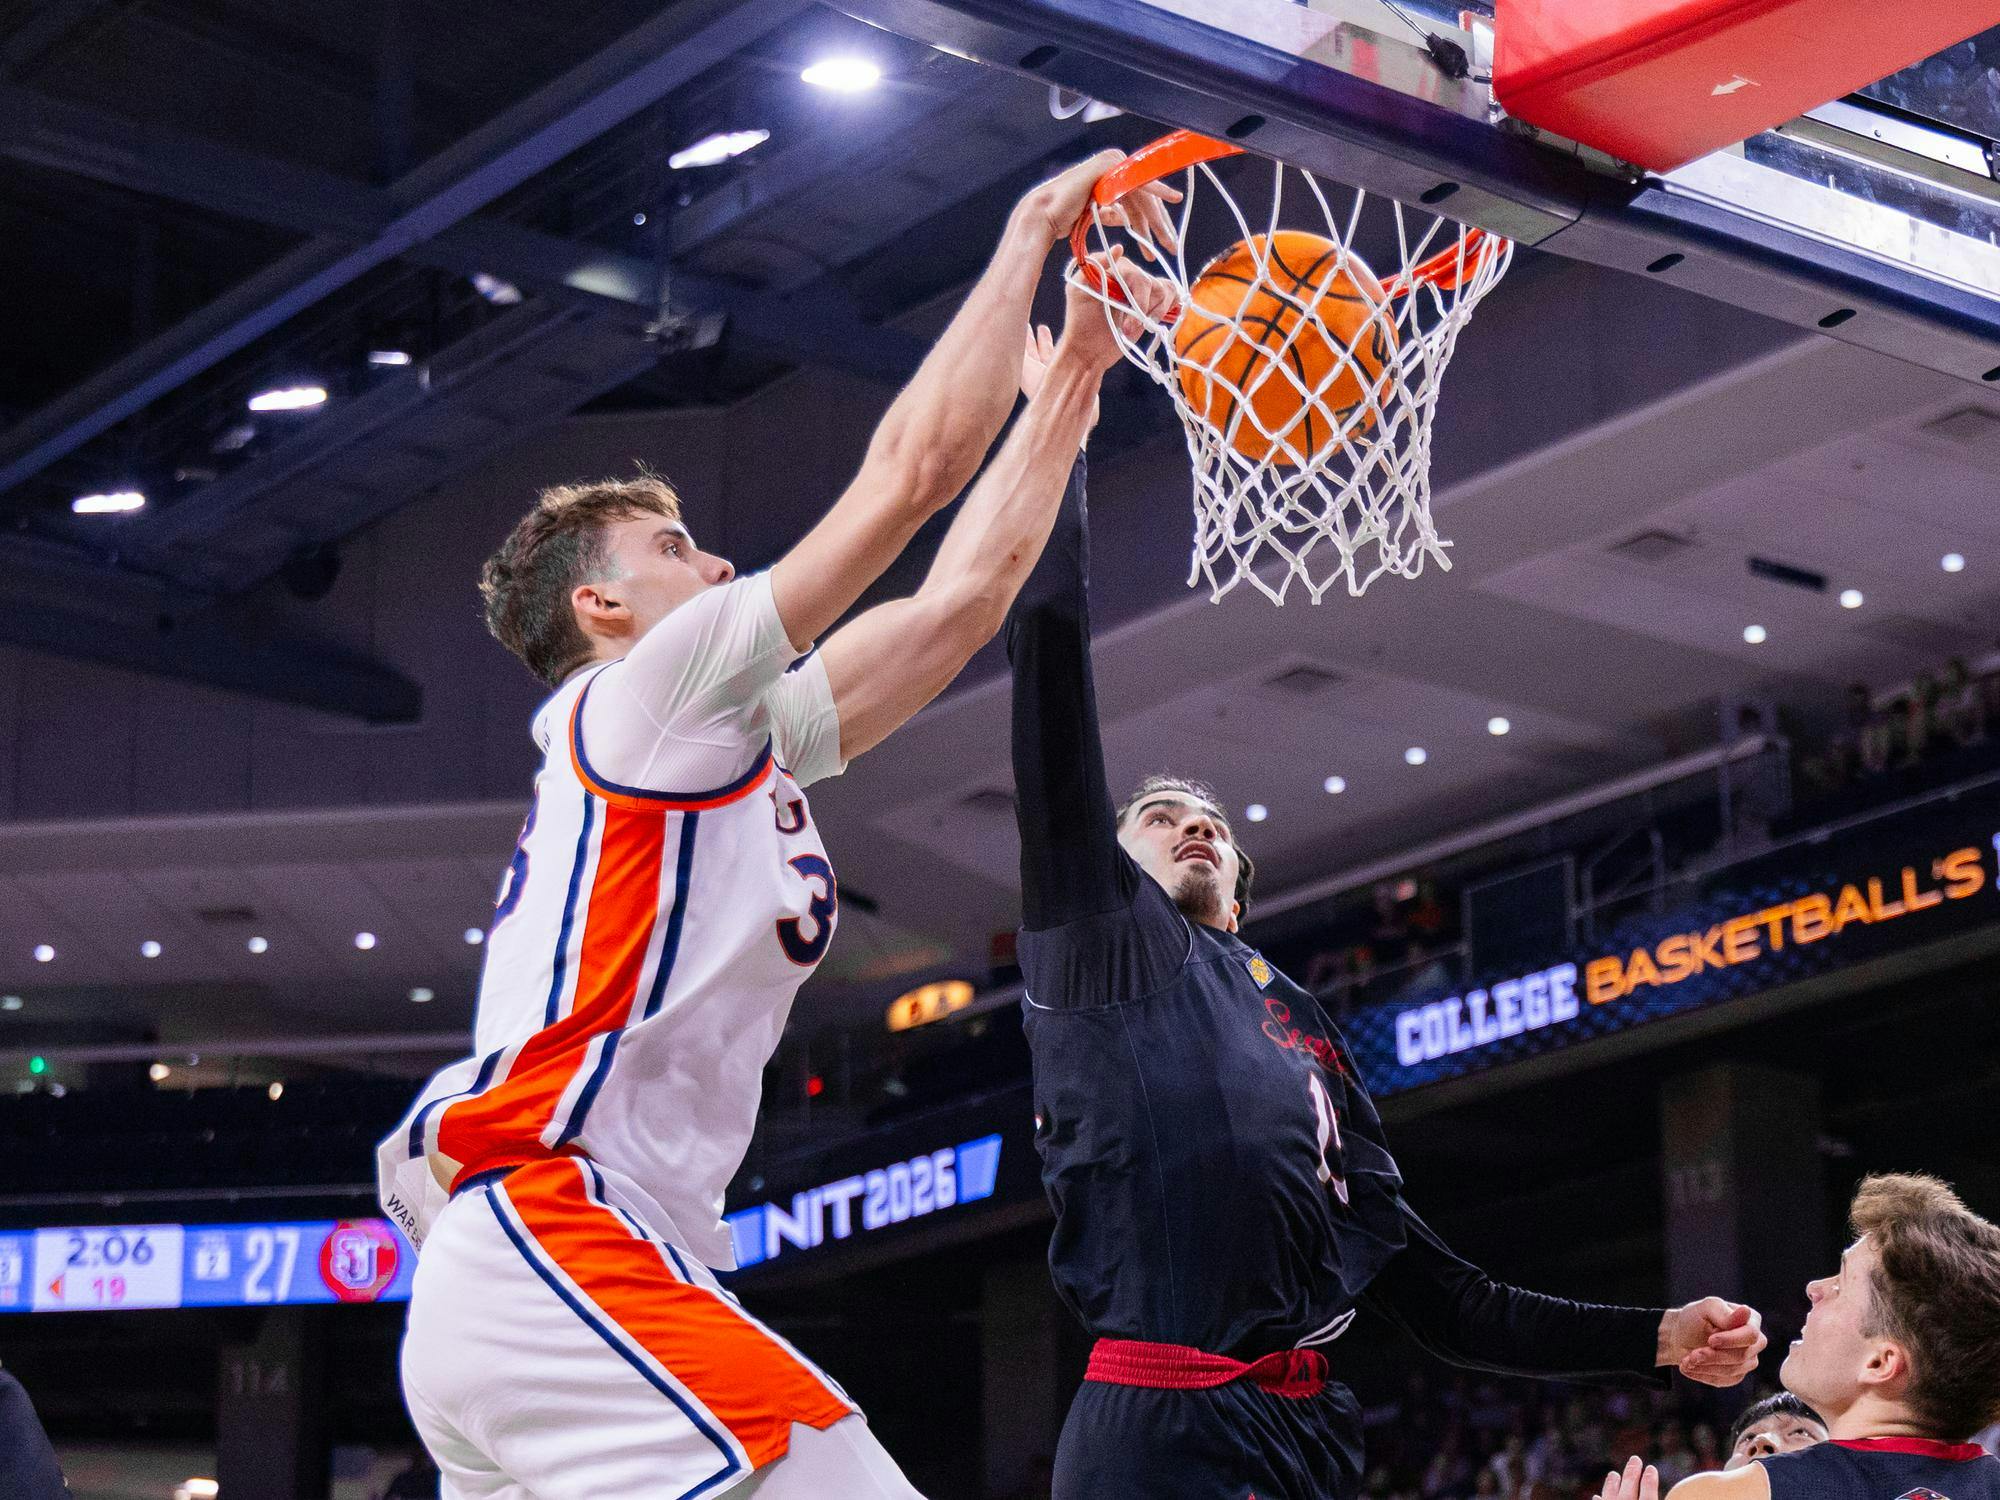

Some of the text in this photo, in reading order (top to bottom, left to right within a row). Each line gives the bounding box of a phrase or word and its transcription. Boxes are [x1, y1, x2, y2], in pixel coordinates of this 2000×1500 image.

[776, 854, 838, 967] 3
[1396, 963, 1580, 1067] COLLEGE
[1586, 846, 1985, 1005] BASKETBALL'S
[387, 1193, 415, 1232] WAR
[66, 1235, 154, 1267] 2:06
[245, 1227, 299, 1302] 27
[93, 1276, 126, 1301] 19
